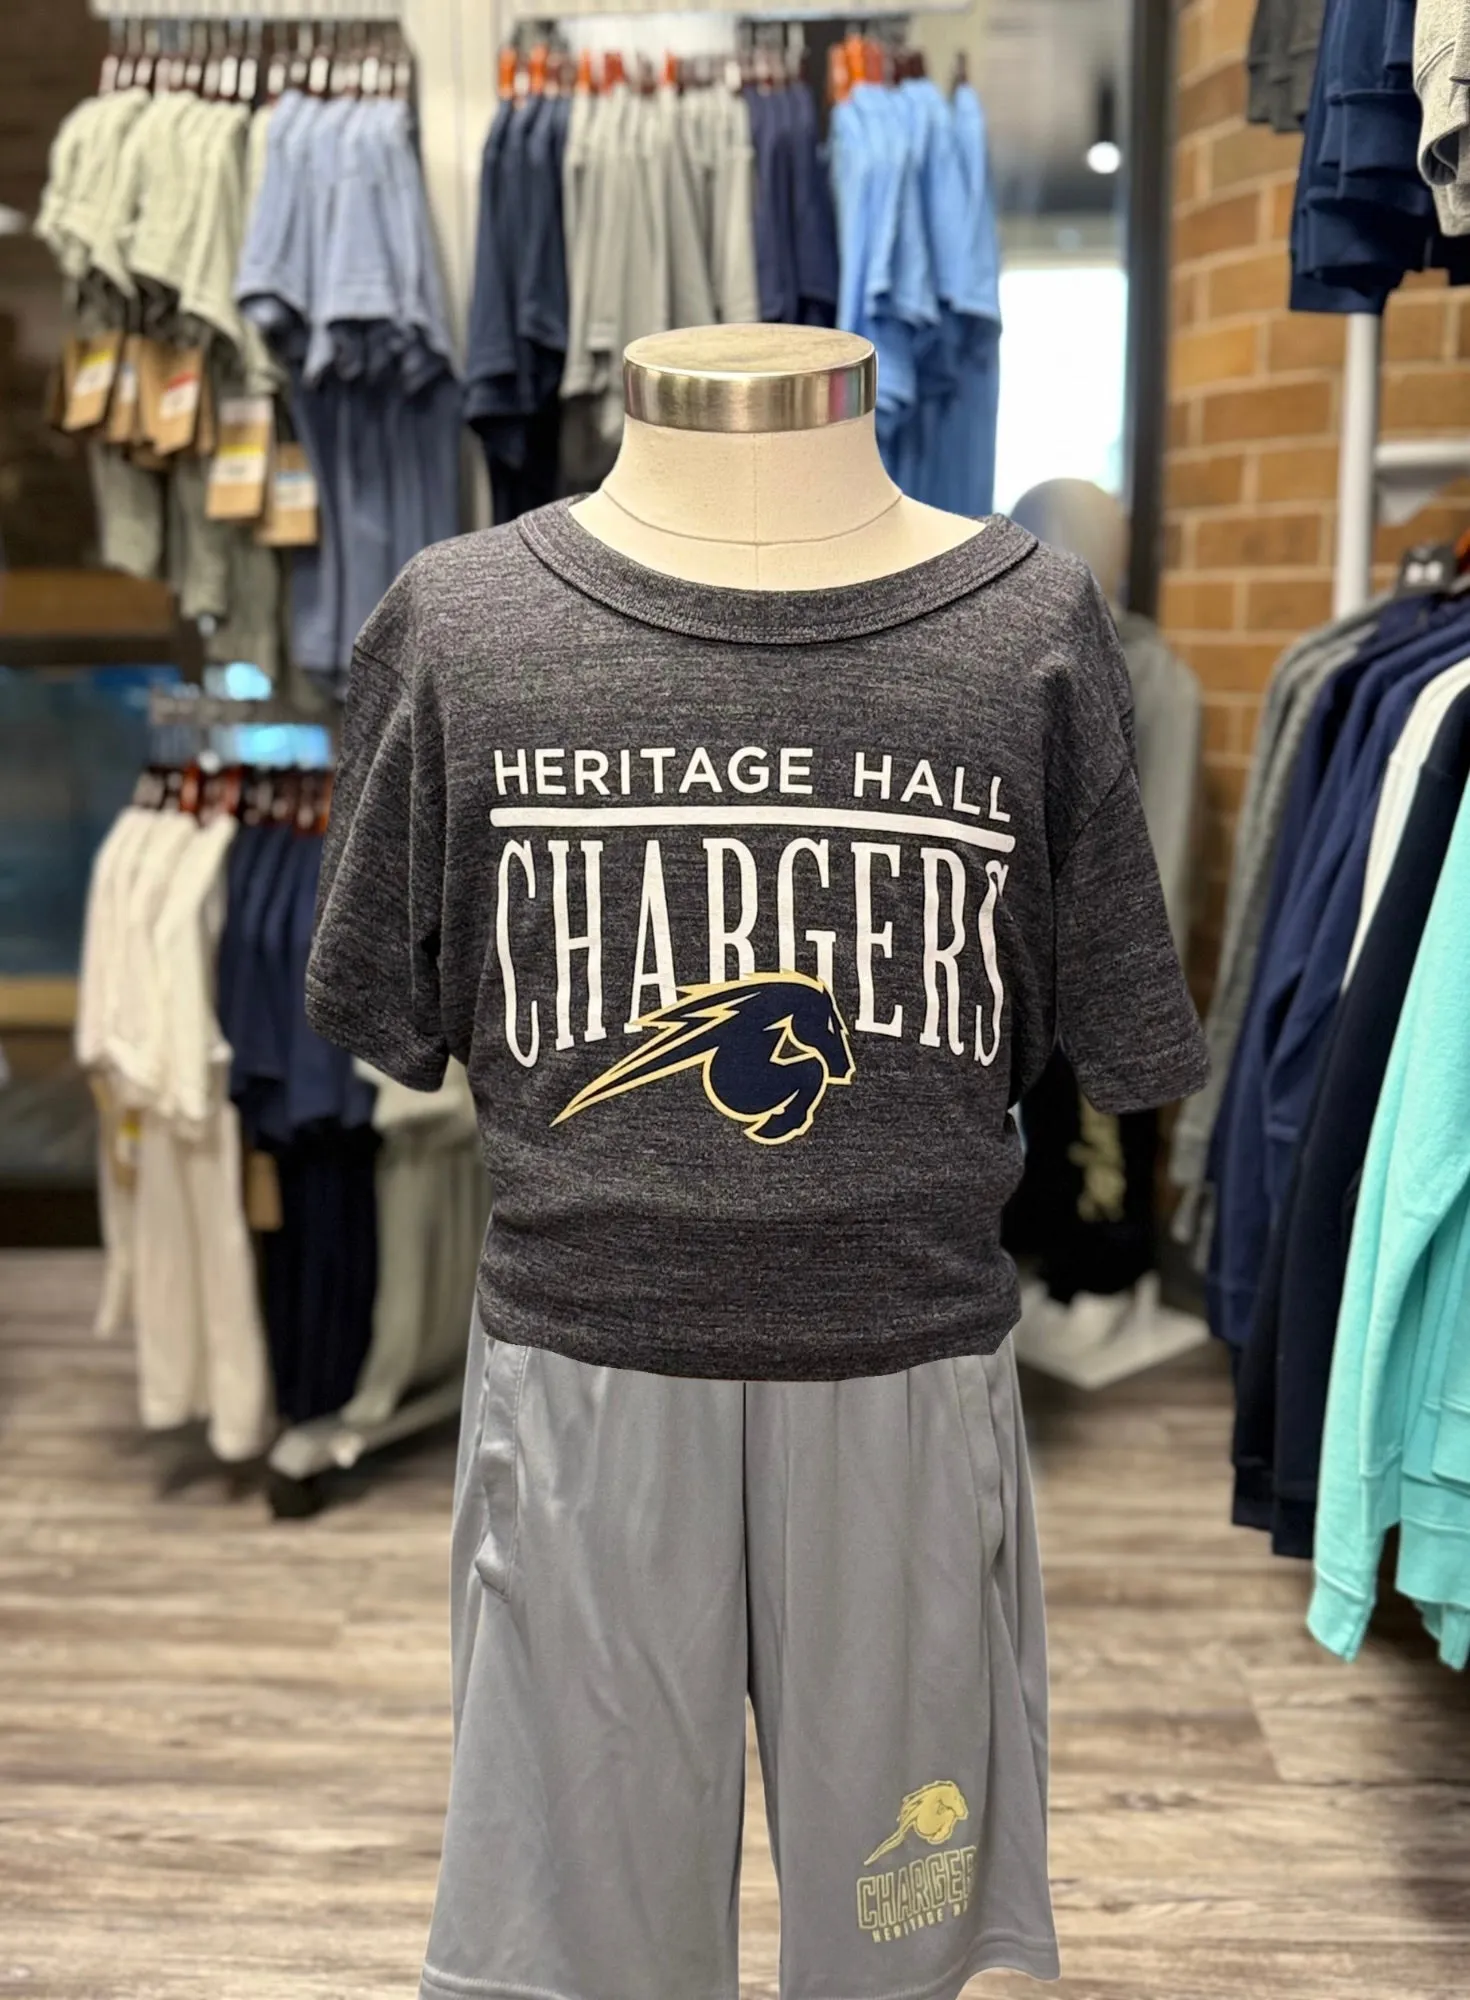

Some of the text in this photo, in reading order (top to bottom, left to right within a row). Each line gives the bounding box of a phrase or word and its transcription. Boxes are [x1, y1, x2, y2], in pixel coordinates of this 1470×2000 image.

[494, 746, 1011, 822] HERITAGE HALL
[496, 837, 1009, 1068] CHARGERS
